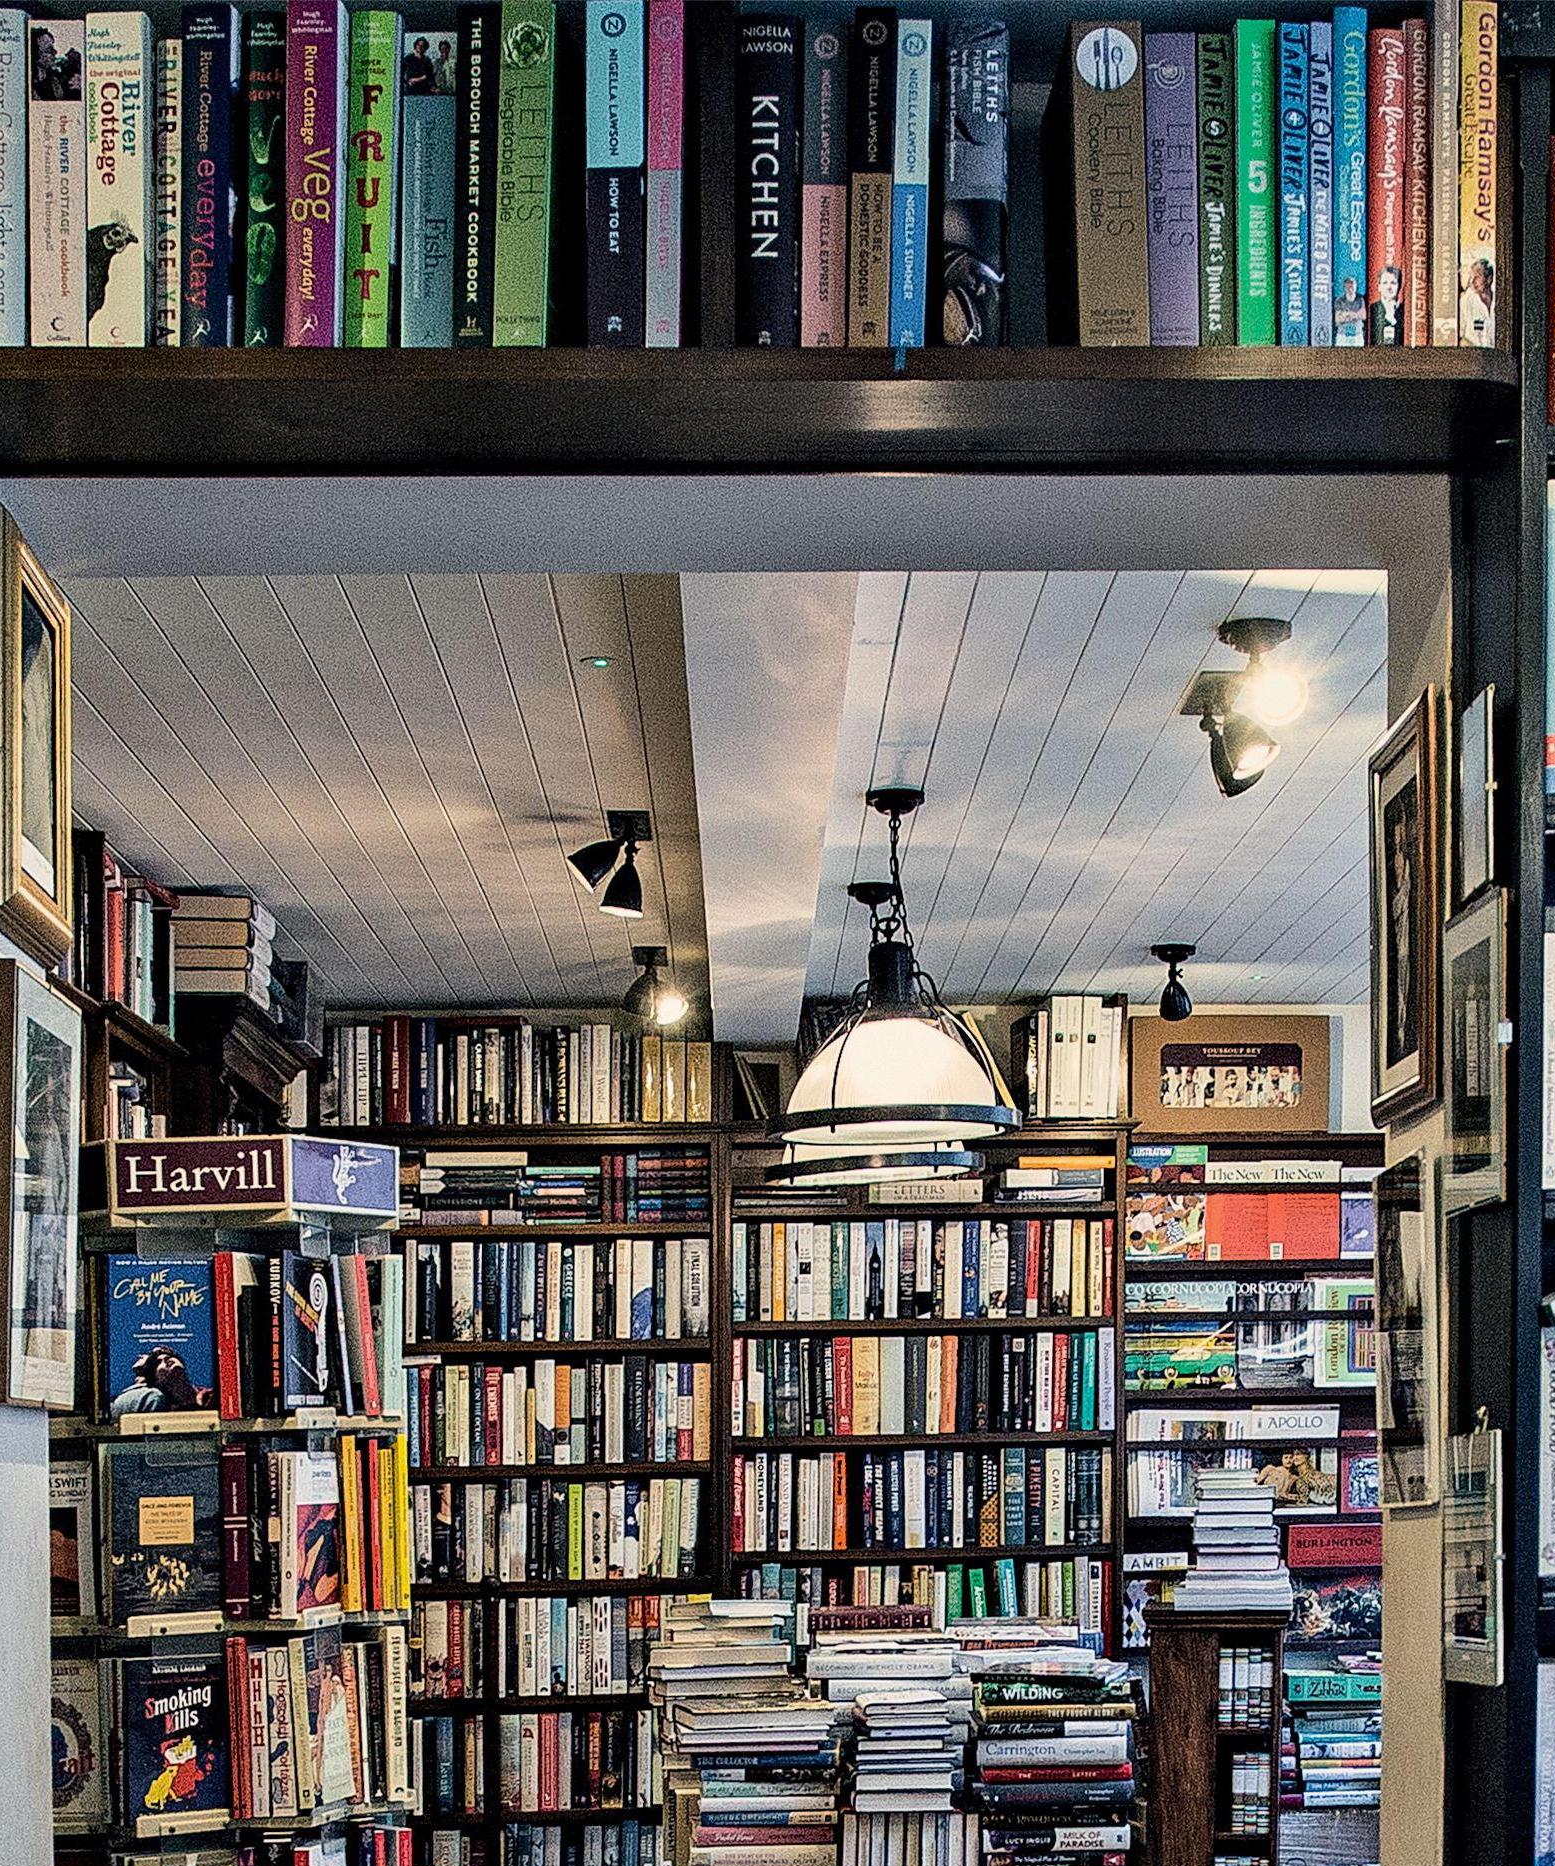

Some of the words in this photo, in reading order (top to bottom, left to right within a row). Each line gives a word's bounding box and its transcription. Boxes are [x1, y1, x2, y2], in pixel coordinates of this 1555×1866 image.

[470, 17, 483, 42] THE
[469, 48, 482, 134] BOROUGH
[120, 81, 140, 156] River
[98, 82, 120, 186] Cottage
[468, 138, 480, 204] MARKET
[751, 95, 778, 259] KITCHEN
[466, 209, 480, 304] COOKBOOK
[125, 1150, 277, 1193] Harvill
[1209, 1168, 1233, 1179] The
[1236, 1168, 1263, 1179] New
[1271, 1168, 1294, 1179] The
[1297, 1168, 1324, 1179] New
[1267, 1415, 1323, 1429] APOLLO
[1050, 1467, 1061, 1511] CAPITAL
[1296, 1537, 1372, 1549] BURLINGTON
[1130, 1554, 1181, 1569] AMBIT
[145, 1685, 212, 1719] Smoking
[1002, 1686, 1063, 1701] WILDING
[1058, 1838, 1103, 1848] PARADISE
[1062, 1829, 1085, 1840] MILK
[1089, 1829, 1102, 1840] OF
